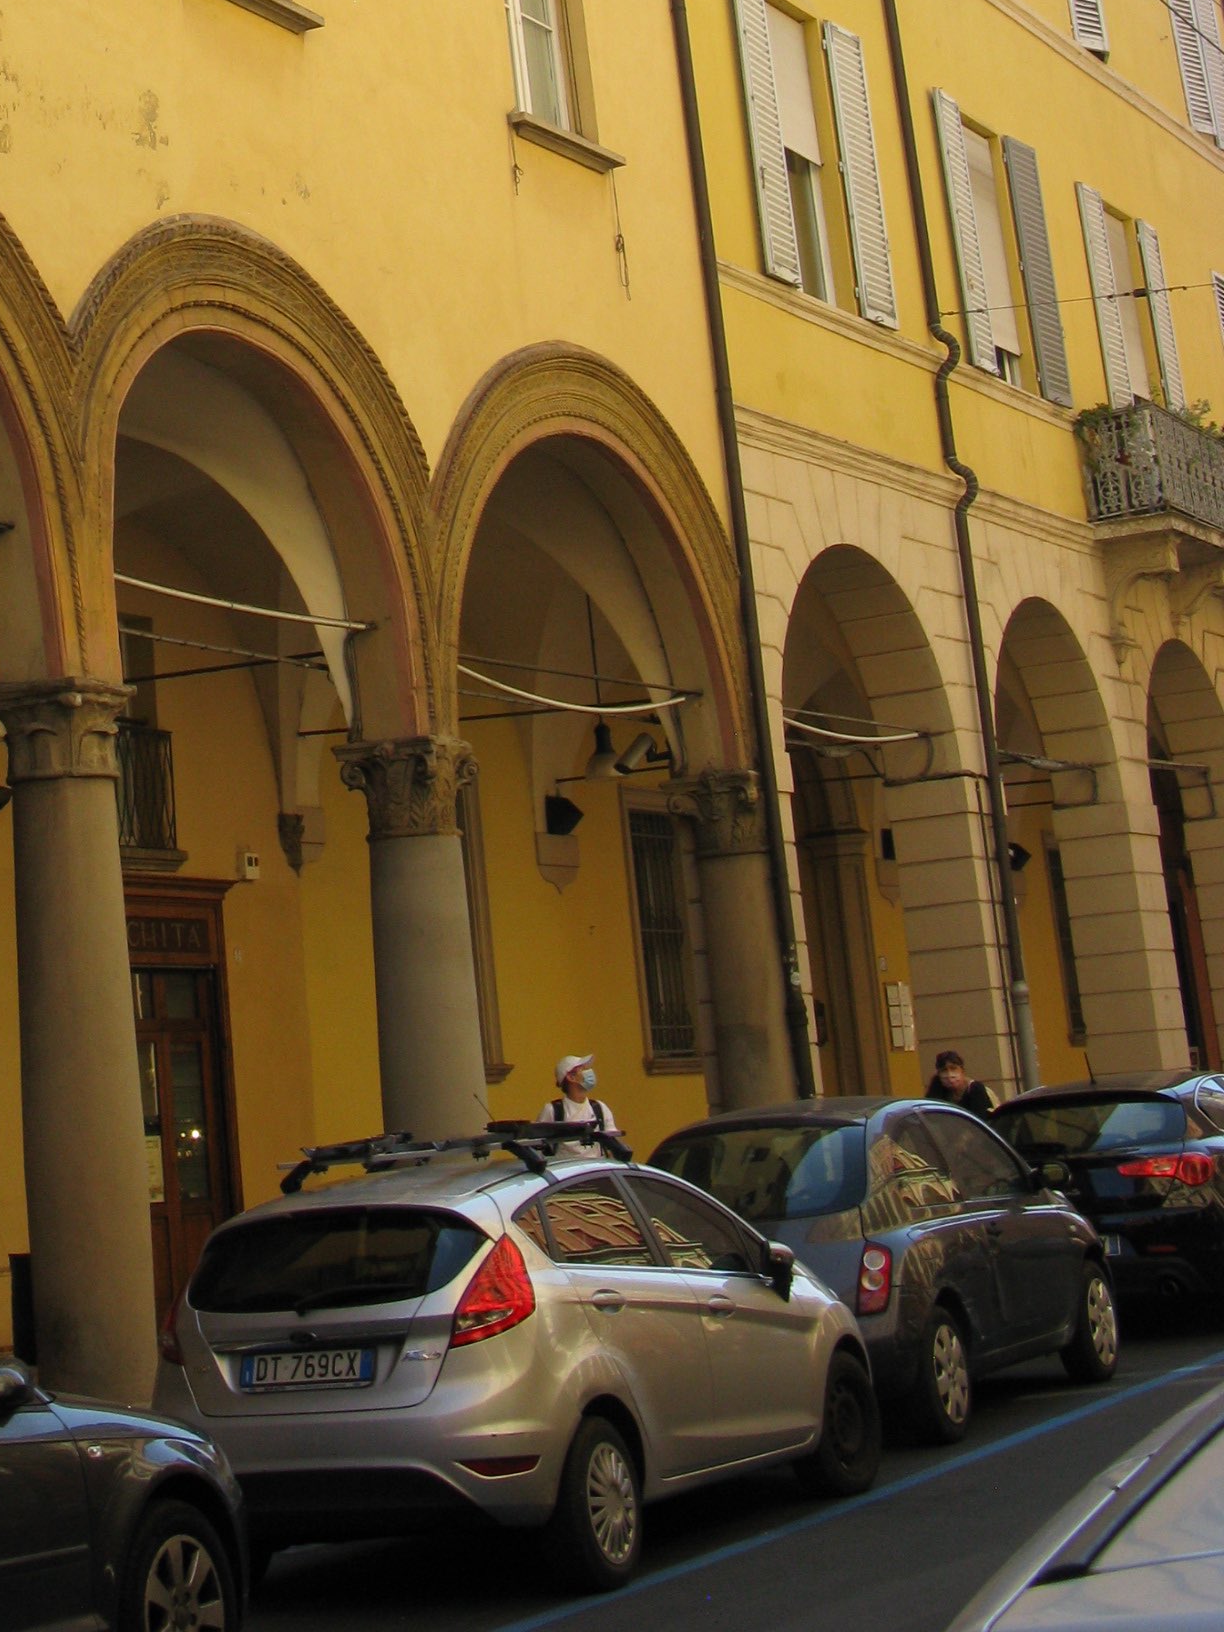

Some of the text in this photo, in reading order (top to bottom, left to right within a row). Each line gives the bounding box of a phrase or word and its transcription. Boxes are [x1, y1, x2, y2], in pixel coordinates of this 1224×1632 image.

[127, 921, 201, 948] CHITÀ
[256, 1356, 282, 1381] DT
[290, 1352, 359, 1379] 769CX
